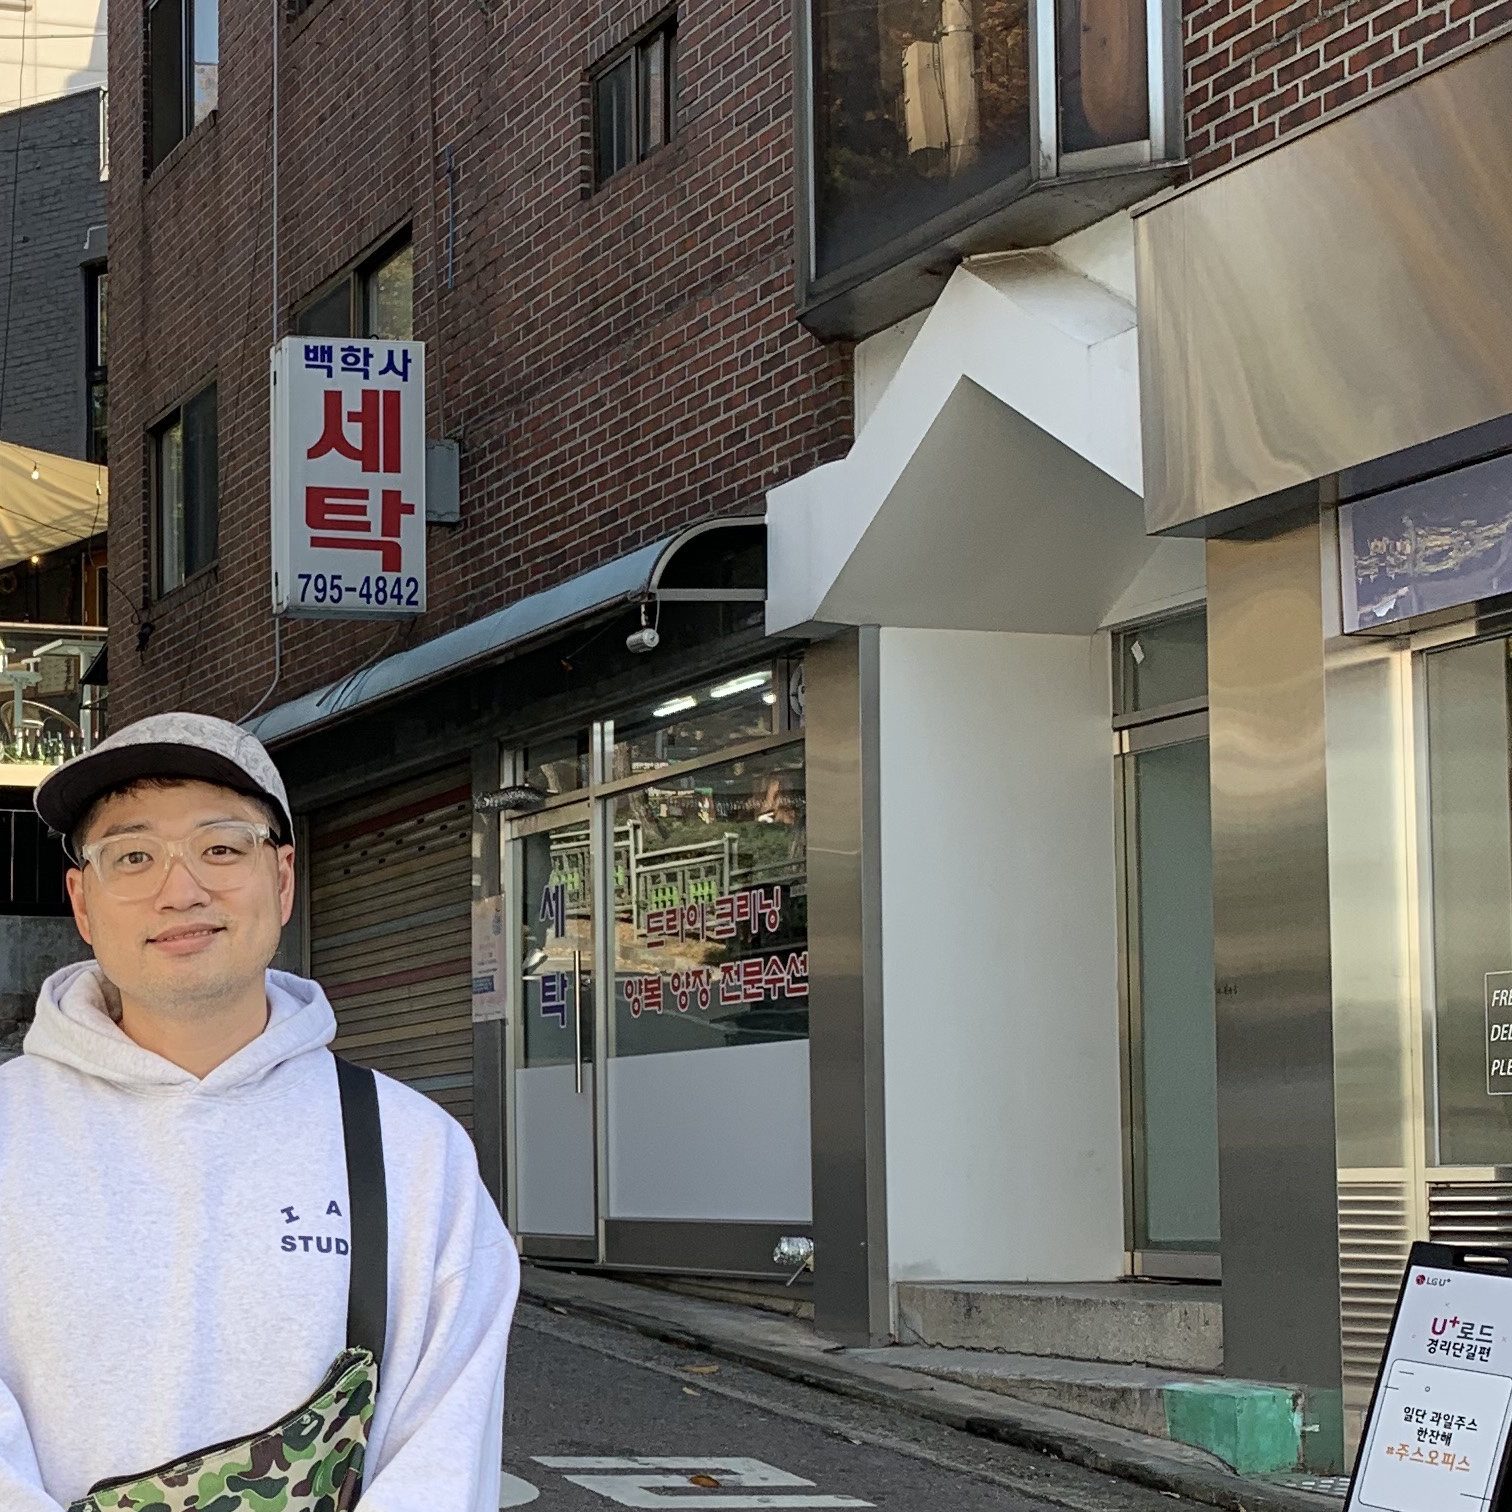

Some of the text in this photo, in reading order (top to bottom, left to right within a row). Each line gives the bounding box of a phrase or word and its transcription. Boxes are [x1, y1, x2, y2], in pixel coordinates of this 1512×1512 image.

[304, 344, 412, 382] 백학사
[306, 389, 415, 573] 세탁
[297, 573, 419, 607] 795-4842
[646, 886, 782, 949] 드라이 크리닝
[624, 952, 809, 1018] 양복 양장 전문수선
[280, 1235, 349, 1256] STUD
[1427, 1338, 1491, 1362] 경리단길편
[1404, 1406, 1477, 1431] 일단 과일주스
[1417, 1427, 1453, 1447] 한잔해
[1386, 1443, 1470, 1472] #주스오피스
